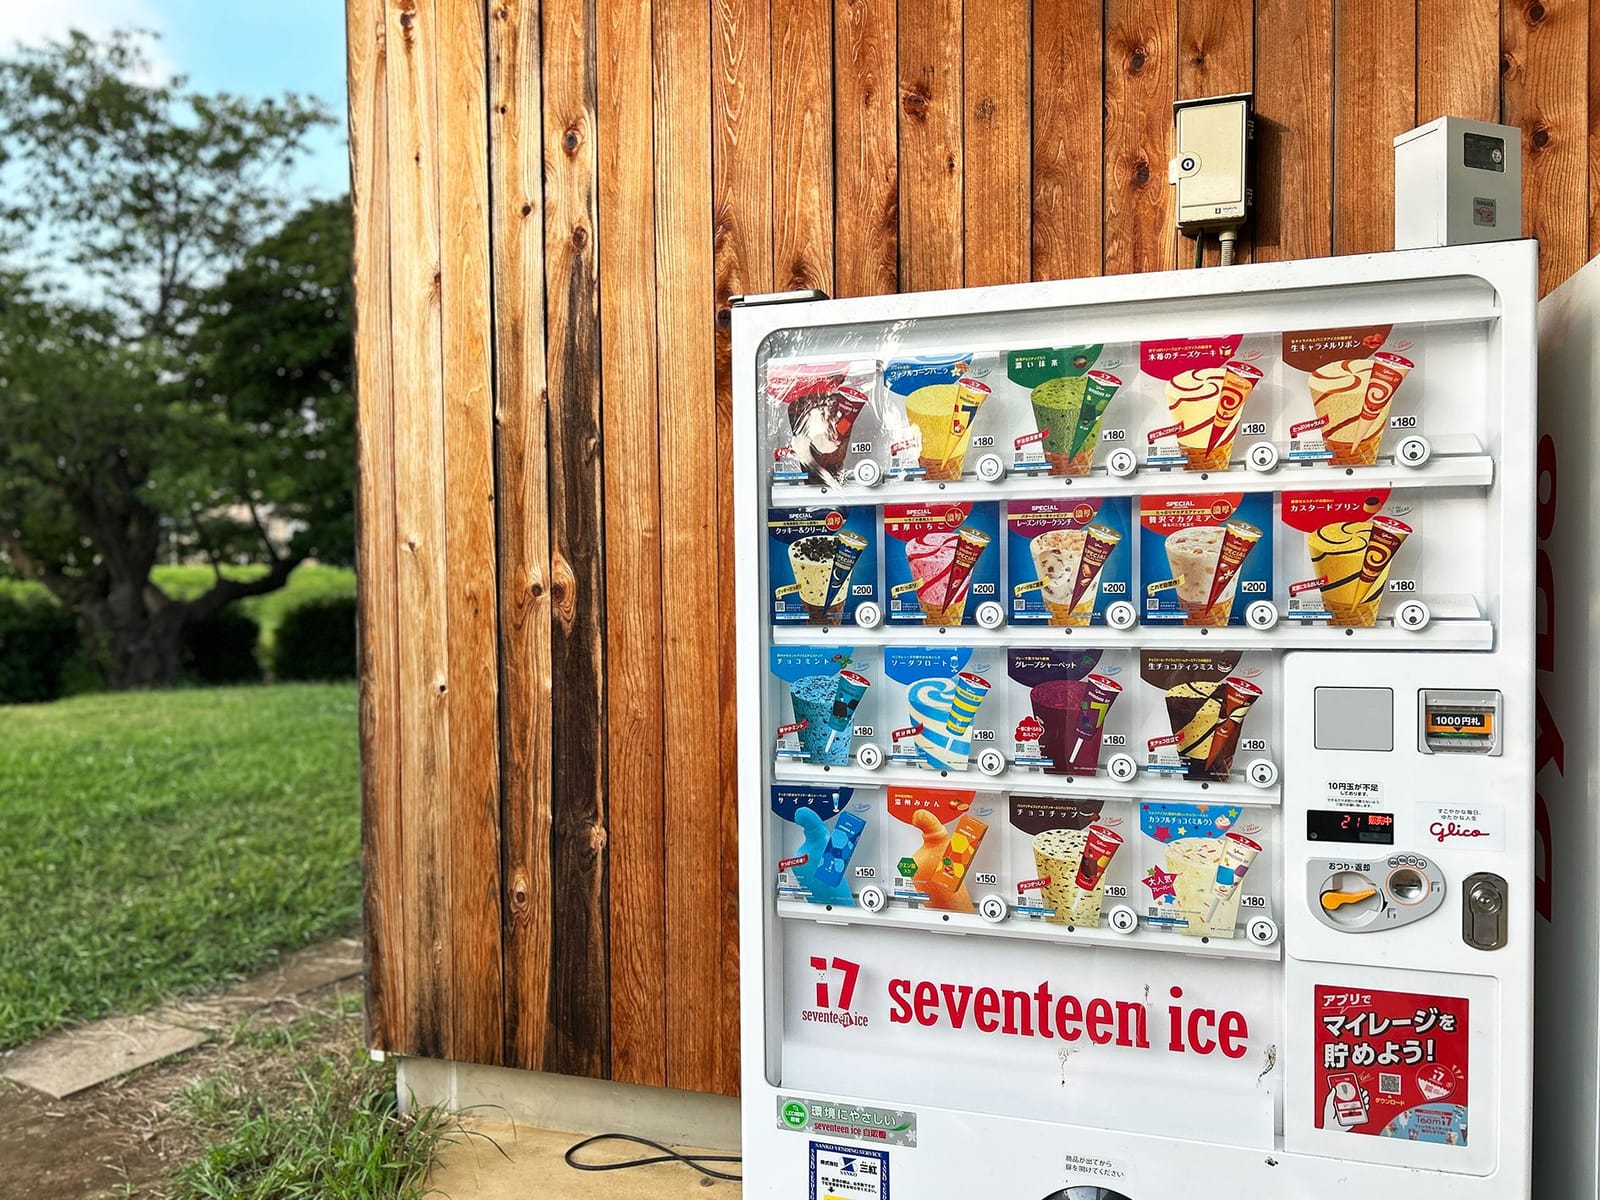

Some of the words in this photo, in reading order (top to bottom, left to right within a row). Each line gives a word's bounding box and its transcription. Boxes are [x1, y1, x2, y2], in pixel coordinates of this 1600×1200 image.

[1290, 339, 1362, 353] 生キャラメルリボン
[1391, 417, 1416, 427] ¥180
[1242, 424, 1266, 433] ¥180
[1104, 431, 1125, 439] ¥180
[974, 437, 994, 447] ¥180
[852, 443, 871, 453] ¥180
[1290, 503, 1361, 512] カスタードプリン
[1017, 518, 1072, 527] レーズンバタークランチ
[1149, 514, 1211, 524] 贅沢マカダミア
[891, 522, 945, 531] 濃厚いちご
[853, 586, 872, 594] ¥200
[974, 585, 994, 593] ¥200
[1104, 583, 1125, 592] ¥200
[1242, 582, 1266, 591] ¥200
[1390, 581, 1415, 590] ¥180
[891, 659, 948, 667] ソーダフロート
[1015, 661, 1077, 669] グレープシャーベット
[1148, 662, 1215, 671] 生チョコティラミス
[1435, 715, 1481, 726] 1000円札
[854, 727, 873, 735] ¥180
[974, 731, 994, 739] ¥180
[1104, 735, 1125, 744] ¥180
[1242, 740, 1265, 749] ¥180
[1327, 782, 1379, 792] 10円玉が不足
[1017, 809, 1078, 818] チョコチップ
[1440, 814, 1477, 822] ゆたかな人生
[1368, 815, 1393, 826] 販売中
[1429, 822, 1491, 843] Glico
[1328, 862, 1371, 872] おつり・返却
[856, 868, 875, 877] ¥150
[976, 874, 996, 884] ¥150
[1148, 875, 1173, 887] 大人気
[1105, 887, 1126, 896] ¥180
[1242, 897, 1265, 907] ¥180
[1323, 993, 1372, 1007] アプリで
[854, 1012, 869, 1027] ice
[888, 978, 1150, 1049] seventeen
[1169, 985, 1249, 1059] ice
[1322, 1007, 1457, 1038] マイレージを
[1323, 1039, 1435, 1069] 貯めよう!
[811, 1104, 897, 1127] 環境にやさしい
[814, 1122, 849, 1134] seventeen
[850, 1125, 862, 1136] ice
[863, 1128, 887, 1139] 自販機
[1065, 1155, 1112, 1168] 商品が出てから
[860, 1164, 878, 1175] 三紅
[1065, 1163, 1125, 1179] 扉を開けてください
